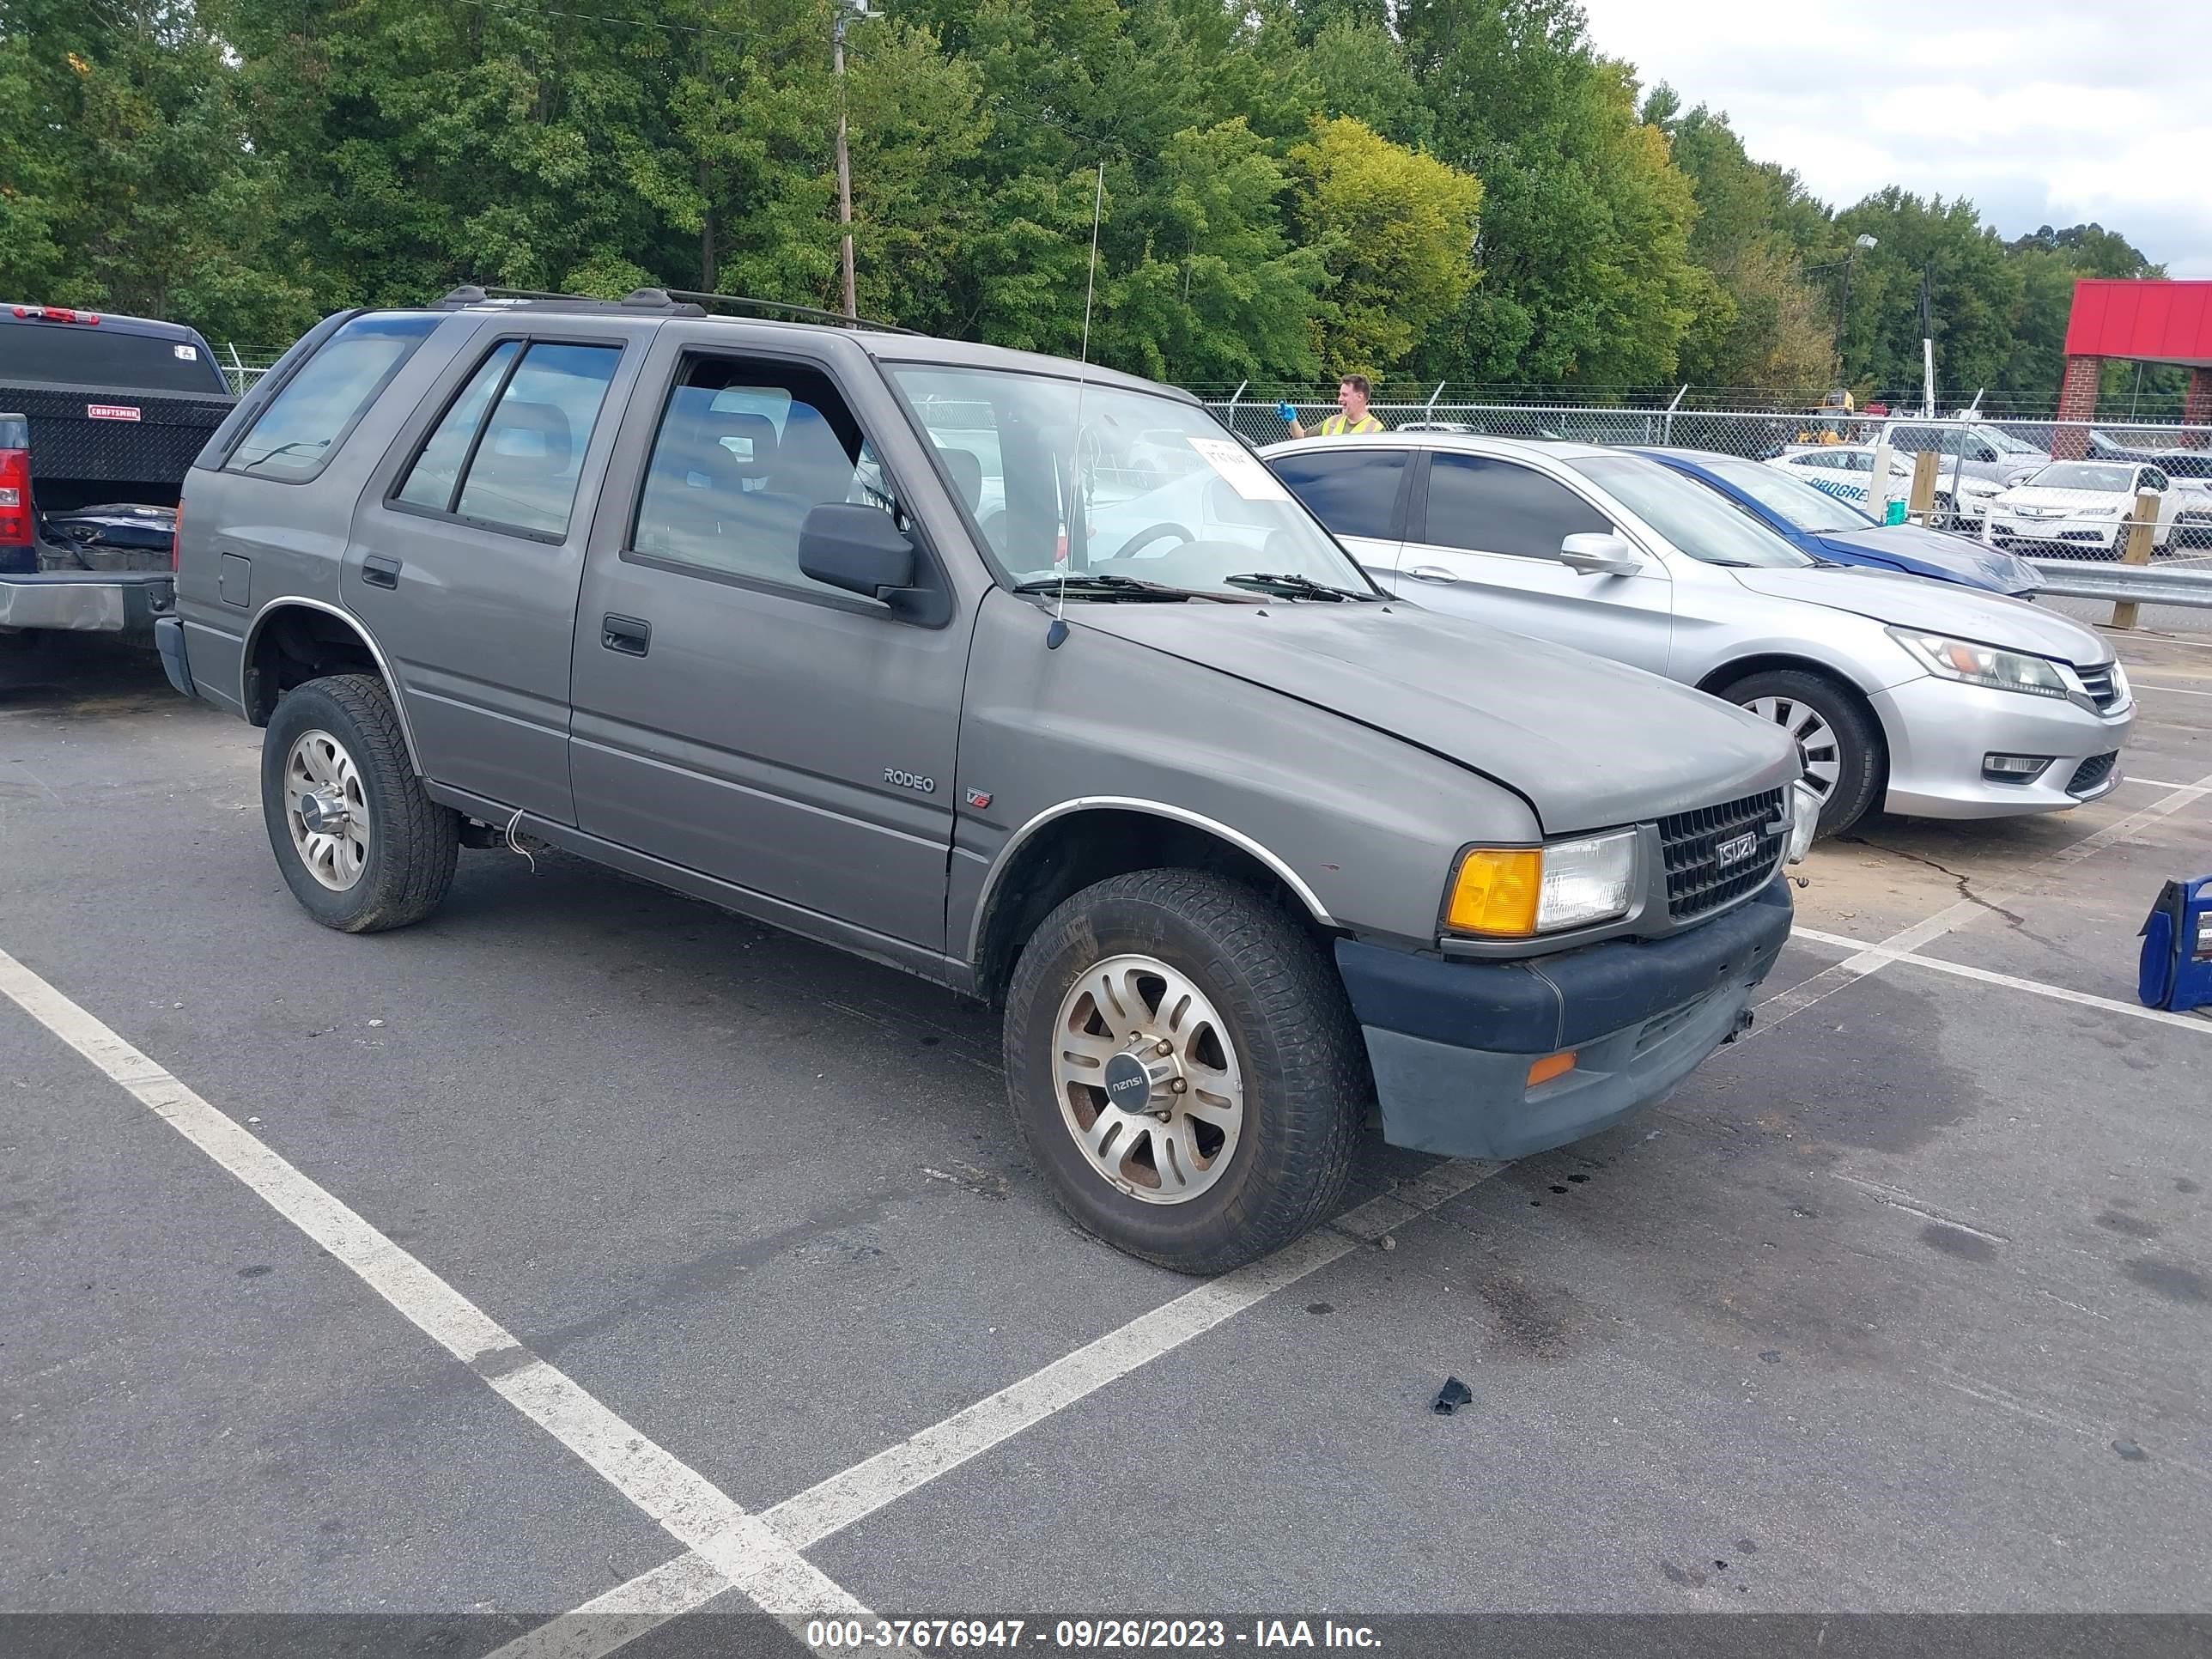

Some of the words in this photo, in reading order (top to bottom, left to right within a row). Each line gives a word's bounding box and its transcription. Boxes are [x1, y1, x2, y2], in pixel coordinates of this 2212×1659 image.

[91, 408, 137, 417] CRAFTSMAN
[884, 768, 934, 793] RODEO
[966, 791, 990, 809] V6
[1719, 835, 1757, 870] ISUZU
[1112, 1075, 1143, 1092] ISUZU
